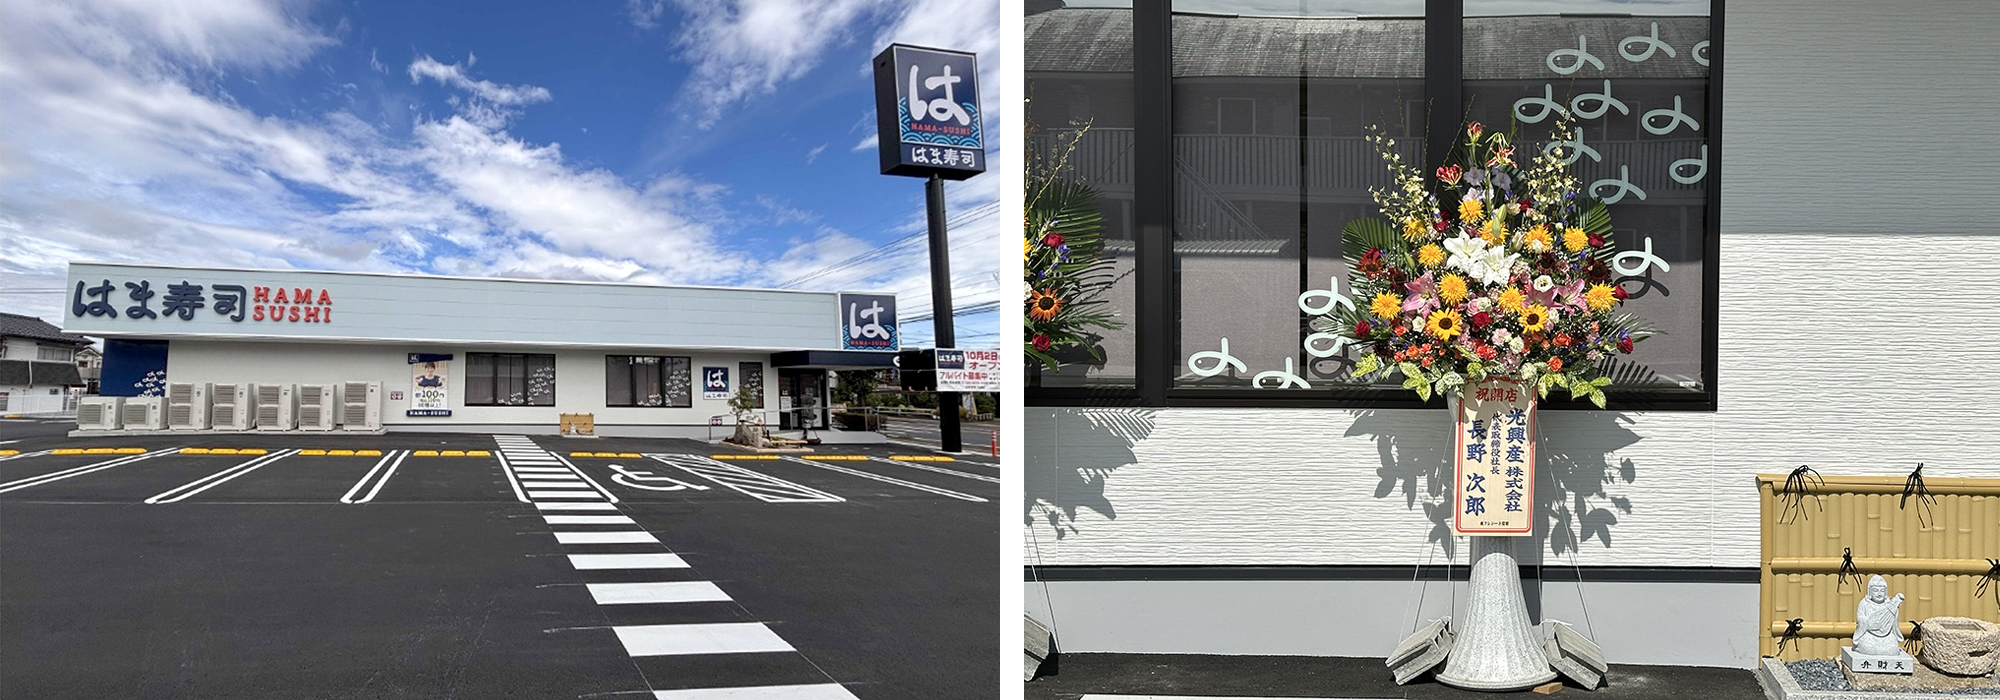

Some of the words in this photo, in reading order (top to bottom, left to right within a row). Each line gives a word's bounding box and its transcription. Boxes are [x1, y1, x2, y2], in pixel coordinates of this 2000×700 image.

[909, 65, 971, 126] は
[911, 123, 971, 135] HAMA-SUSHI
[912, 147, 975, 168] はま寿司
[72, 279, 247, 322] はま寿司
[253, 286, 332, 305] HAMA
[252, 304, 332, 323] SUSHI
[849, 300, 890, 340] は
[707, 370, 726, 388] は
[1475, 387, 1518, 403] 祝開店
[1466, 419, 1487, 463] 長野
[1490, 413, 1502, 475] 代表取締役社長
[1464, 472, 1486, 516] 次郎
